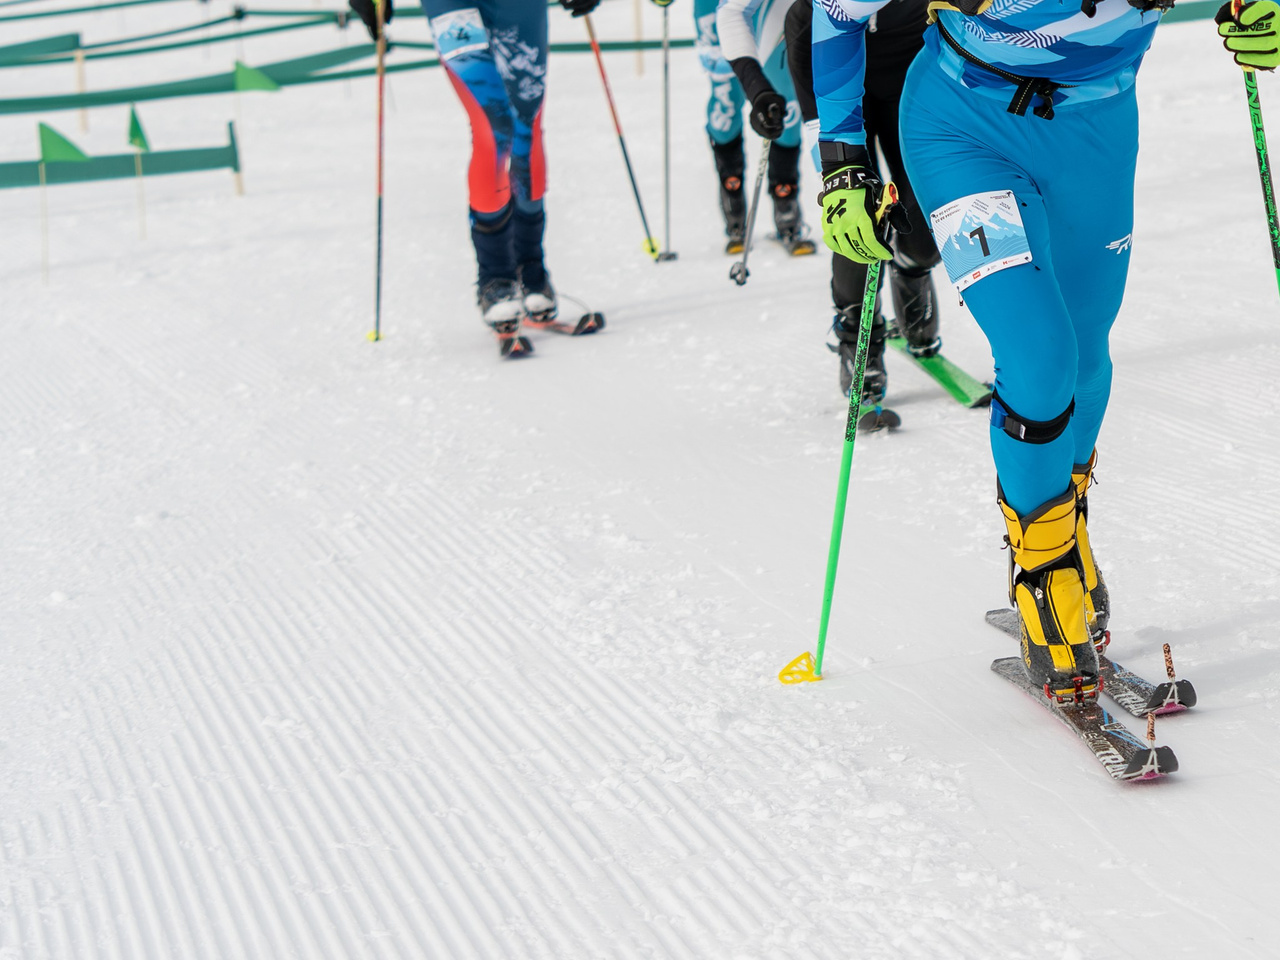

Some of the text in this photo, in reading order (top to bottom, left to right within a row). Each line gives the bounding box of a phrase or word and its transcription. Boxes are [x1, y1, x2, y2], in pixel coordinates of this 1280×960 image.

[456, 27, 471, 41] 4
[969, 226, 990, 257] 1
[1096, 747, 1129, 779] TRA
